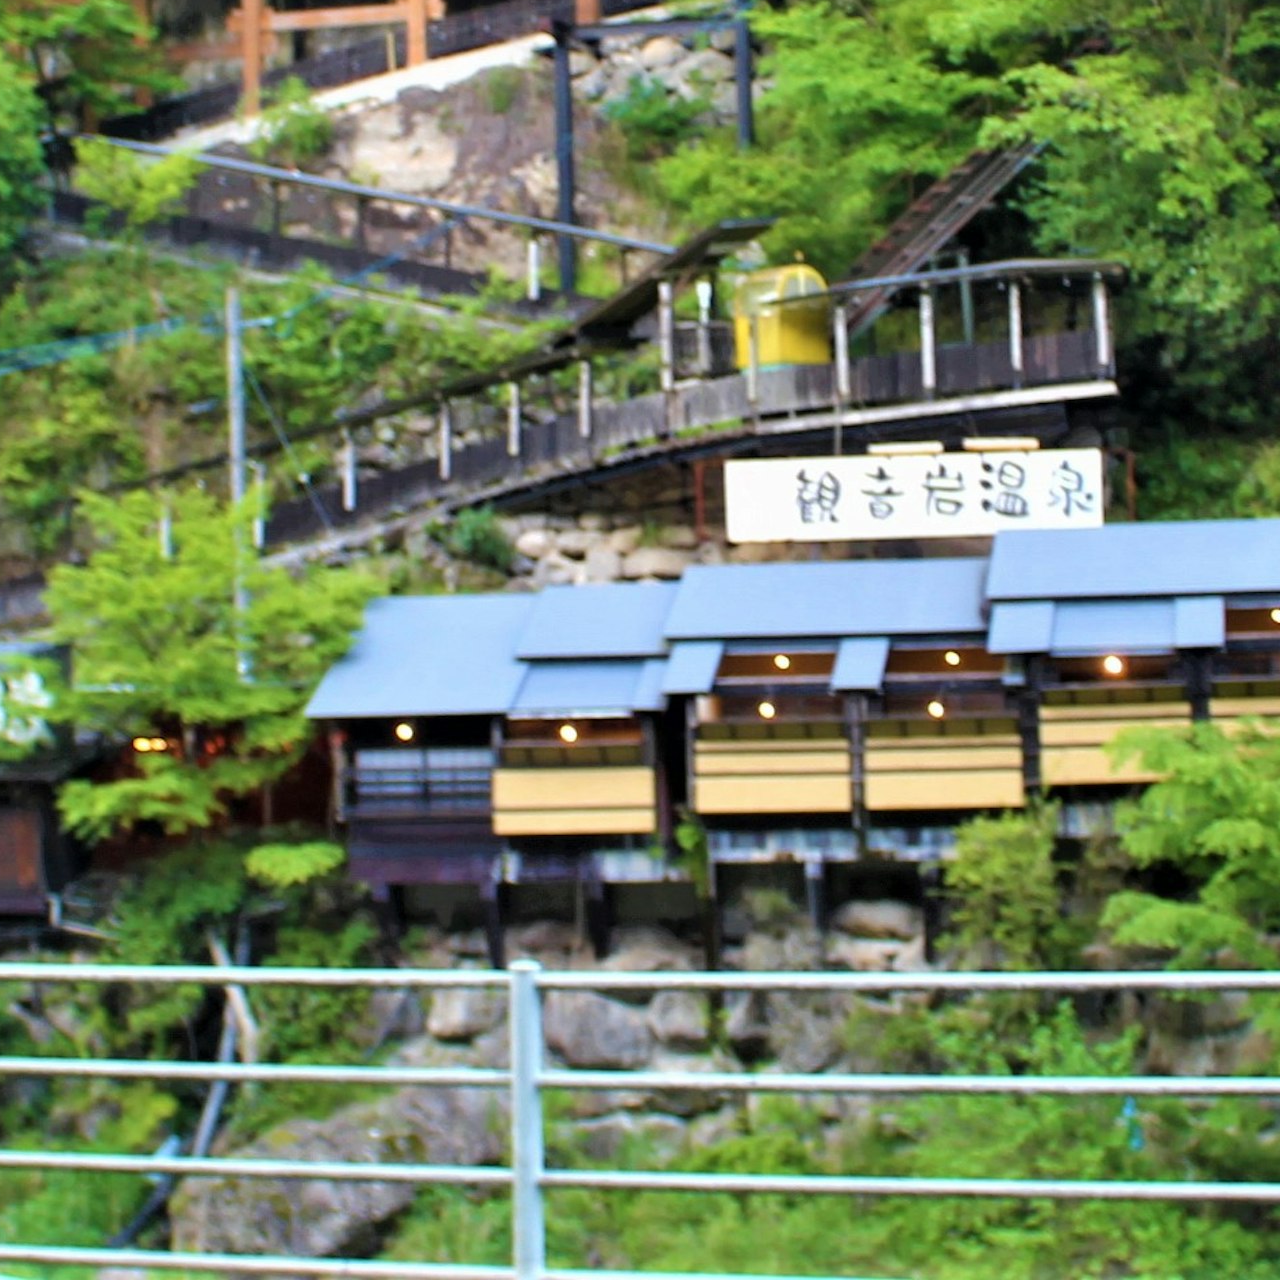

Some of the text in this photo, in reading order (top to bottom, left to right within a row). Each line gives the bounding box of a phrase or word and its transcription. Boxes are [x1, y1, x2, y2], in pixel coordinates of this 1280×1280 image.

[796, 460, 1094, 524] 観音岩温泉
